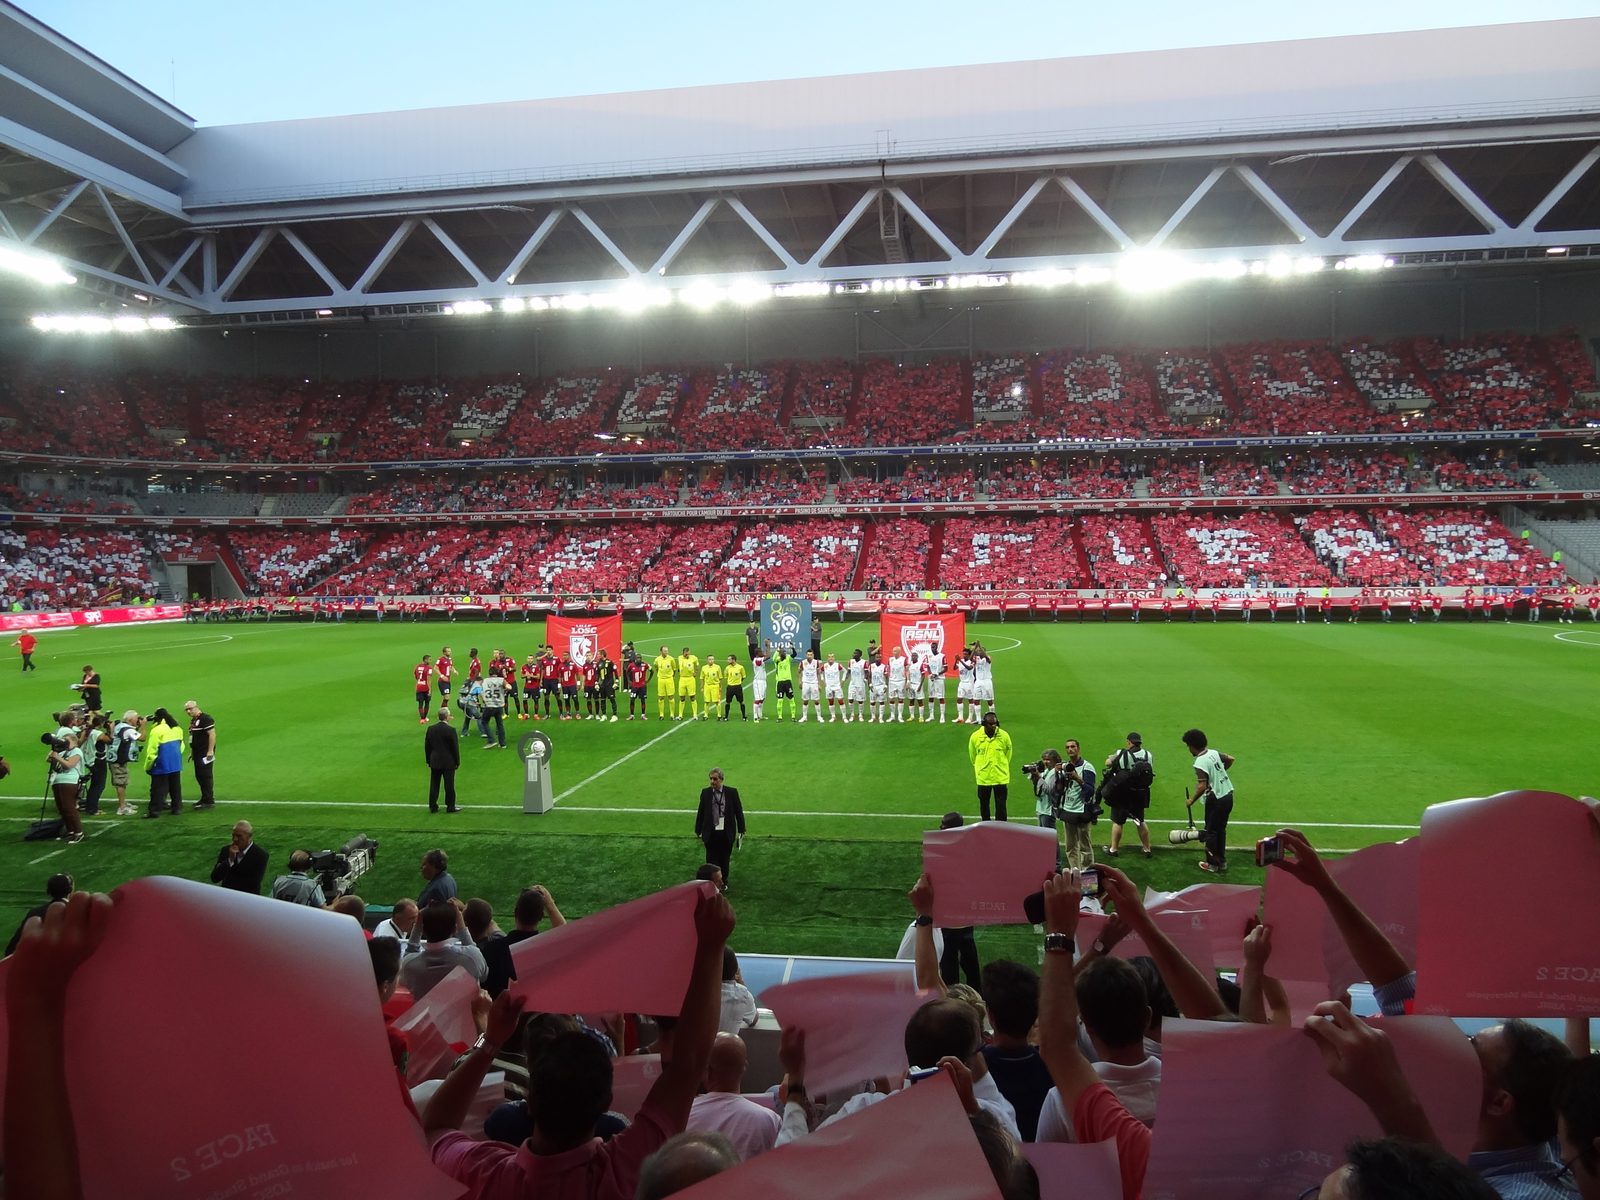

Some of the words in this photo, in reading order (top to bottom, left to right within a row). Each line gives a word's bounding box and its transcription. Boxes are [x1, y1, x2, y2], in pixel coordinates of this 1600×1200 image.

[1374, 589, 1414, 598] LOSC
[906, 630, 941, 638] ASNL
[485, 689, 500, 699] 35
